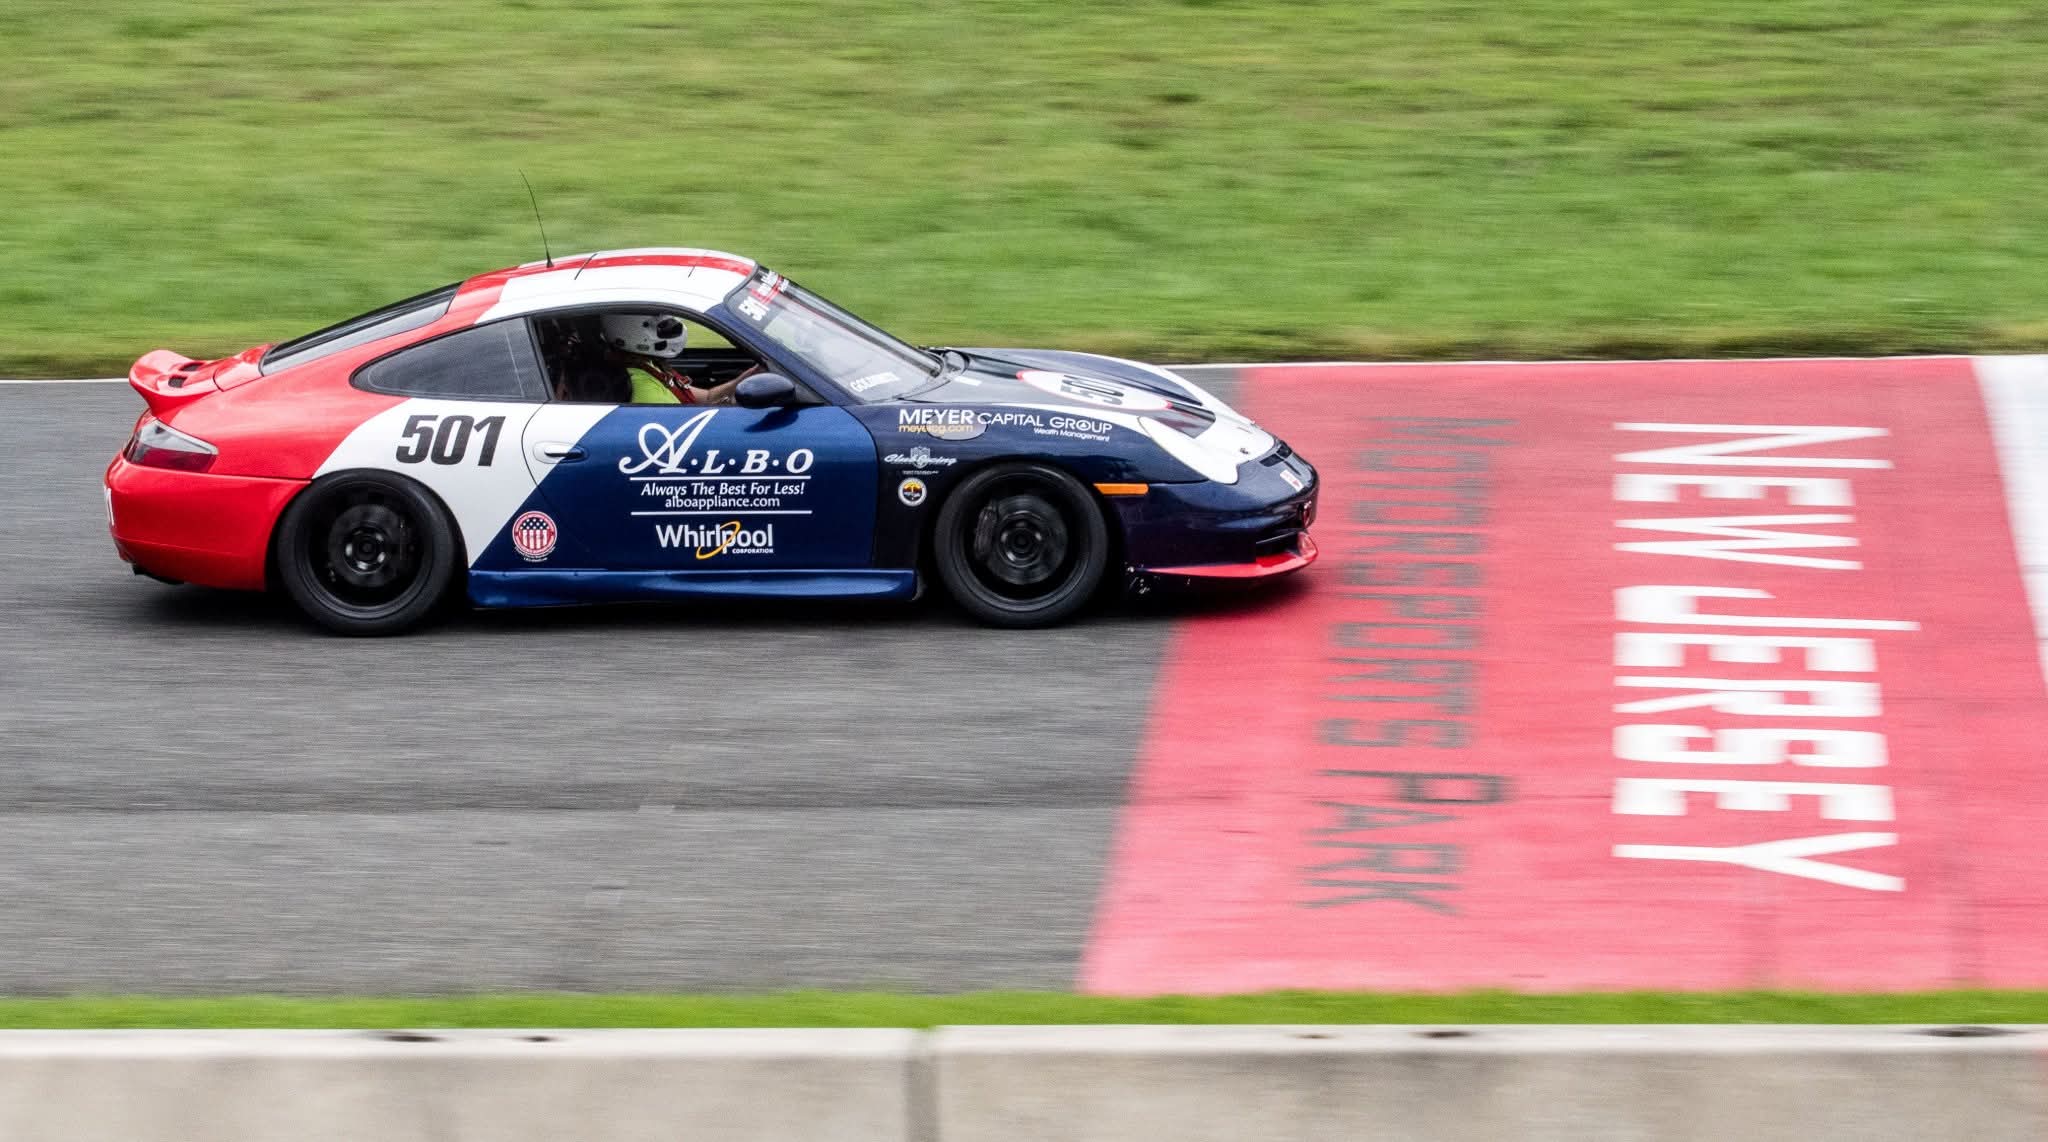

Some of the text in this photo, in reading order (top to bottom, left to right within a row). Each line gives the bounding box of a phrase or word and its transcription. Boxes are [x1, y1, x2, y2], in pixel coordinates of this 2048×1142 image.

[899, 408, 1113, 434] MEYER CAPITAL GROUP
[1033, 427, 1110, 442] Wealth Management
[395, 414, 507, 467] 501
[641, 482, 805, 499] Always The Best For Less!
[664, 496, 780, 510] alboappliance.com
[655, 523, 773, 554] Whirlpool
[1296, 415, 1518, 916] MOTORSPORTS PARK
[1611, 421, 1922, 892] NEW JERSEY
